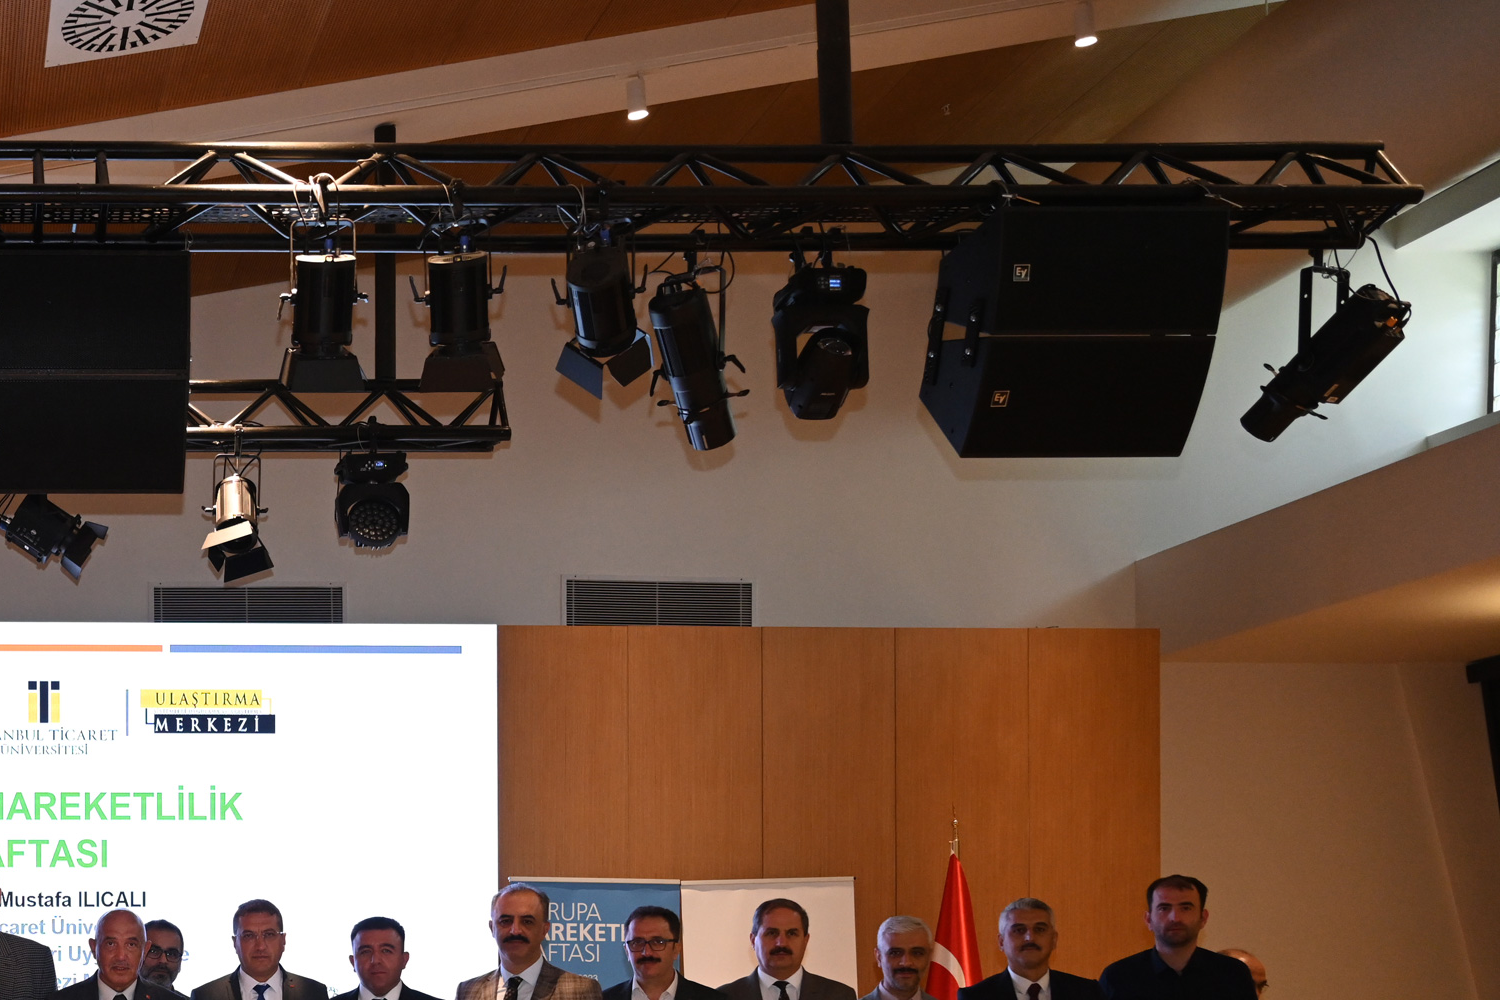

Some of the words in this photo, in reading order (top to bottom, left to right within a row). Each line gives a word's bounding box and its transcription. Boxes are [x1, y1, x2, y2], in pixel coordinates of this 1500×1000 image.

[155, 691, 261, 708] ULAŞTIRMA
[154, 715, 260, 733] MERKEZİ
[49, 726, 118, 741] TİCARET
[0, 743, 88, 756] ÜNİVERSİTESİ
[0, 890, 72, 908] Mustafa
[78, 890, 147, 908] ILICALI
[548, 902, 602, 921] RUPA
